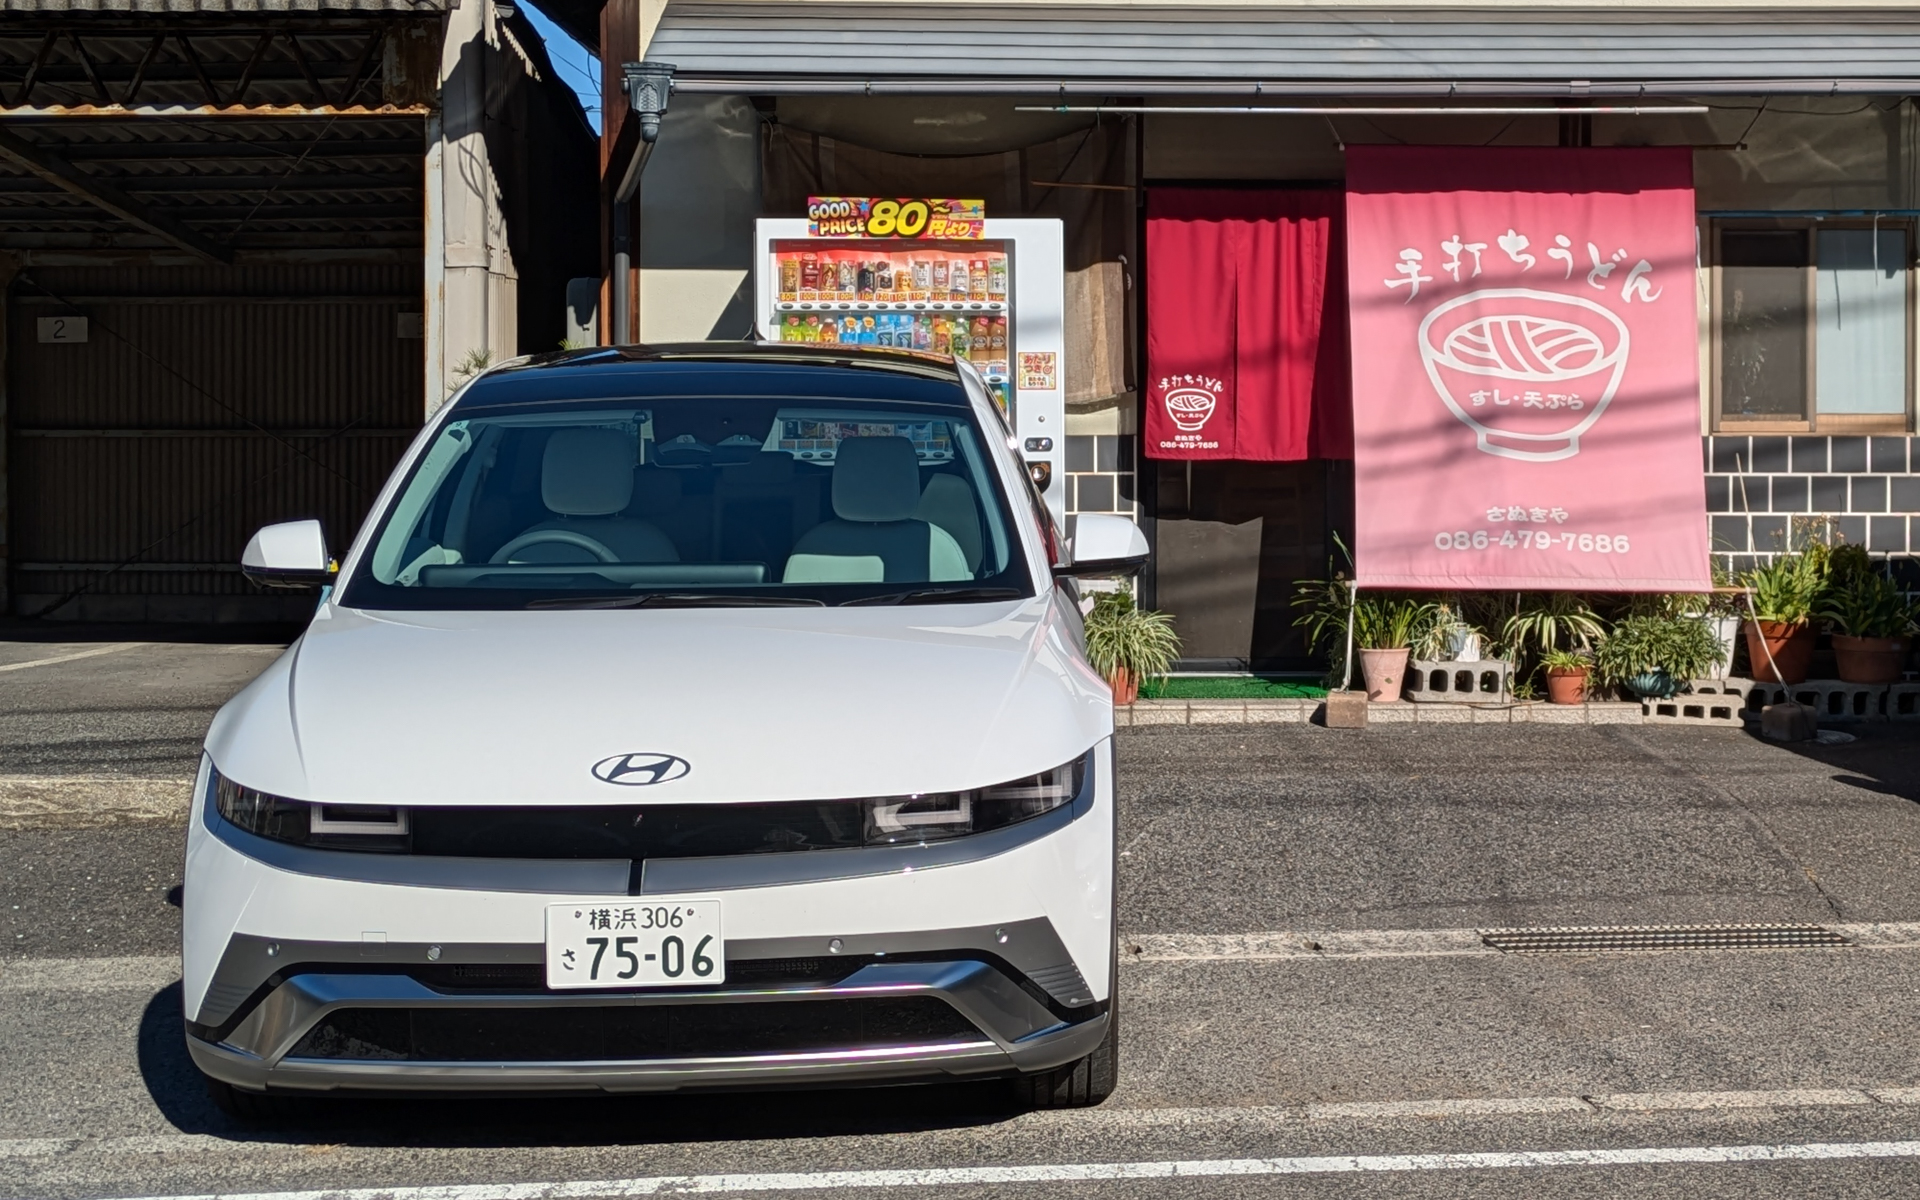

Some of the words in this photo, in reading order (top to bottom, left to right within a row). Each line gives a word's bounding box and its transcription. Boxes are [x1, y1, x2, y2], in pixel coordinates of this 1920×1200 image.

[808, 201, 850, 220] GOOD
[867, 200, 929, 236] 80
[819, 217, 866, 236] PRICE
[927, 218, 971, 236] 円より
[1384, 229, 1663, 304] 手打ちうどん
[53, 319, 66, 339] 2
[1158, 374, 1223, 392] 手打ちうどん
[1469, 389, 1585, 411] すし・天ぷら
[1486, 505, 1569, 524] さぬきや
[1434, 529, 1630, 554] 086-479-7686
[560, 948, 576, 971] さ
[586, 934, 714, 980] 75-06
